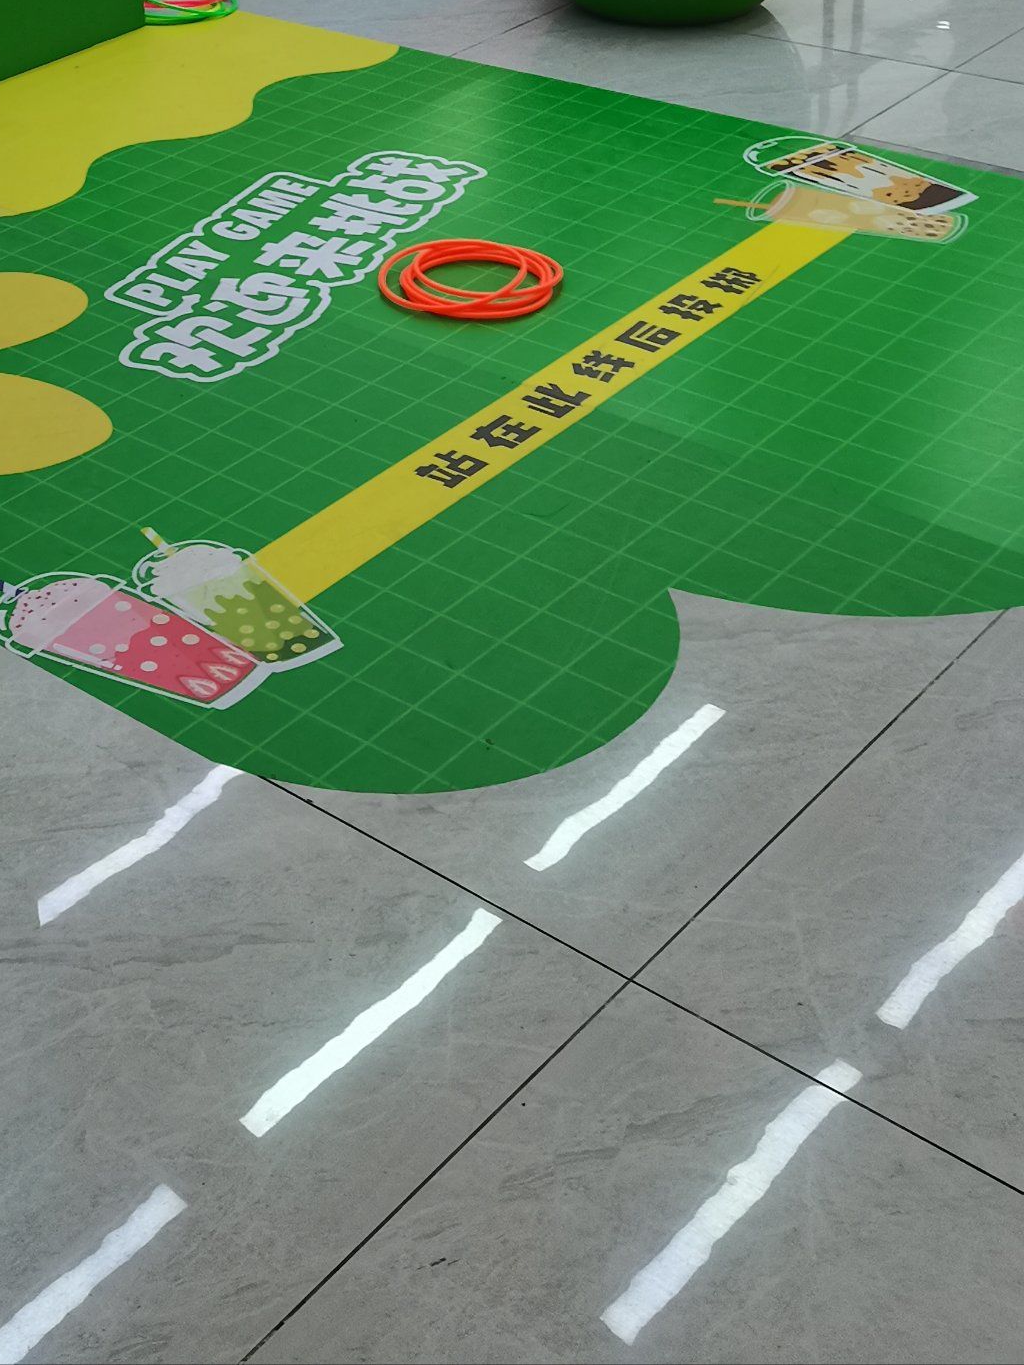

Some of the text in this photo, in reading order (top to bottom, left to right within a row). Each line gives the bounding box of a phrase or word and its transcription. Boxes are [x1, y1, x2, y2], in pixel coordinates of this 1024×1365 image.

[124, 179, 321, 308] PLAY GAME
[141, 157, 469, 373] 欢迎来挑战
[414, 266, 763, 489] 站在此线后投掷
